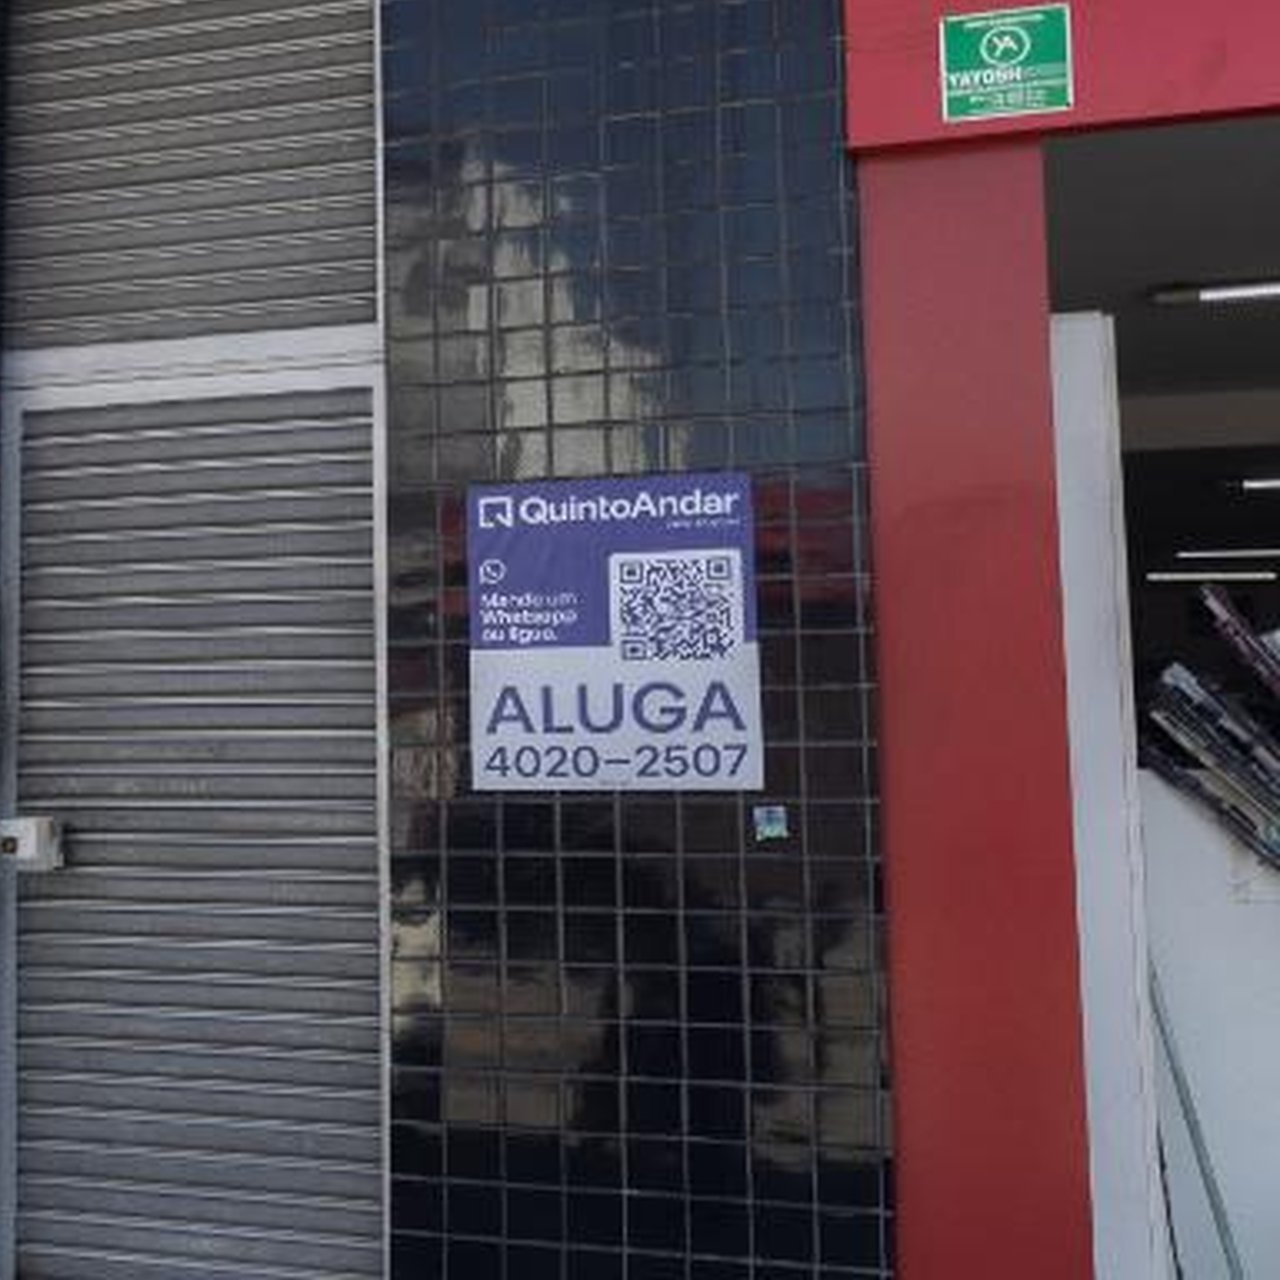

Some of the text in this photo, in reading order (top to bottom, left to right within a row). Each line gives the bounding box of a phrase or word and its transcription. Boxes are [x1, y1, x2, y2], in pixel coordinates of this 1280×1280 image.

[519, 489, 740, 524] QuintoAndar
[485, 681, 747, 734] ALUGA
[484, 744, 748, 778] 4020-2507
